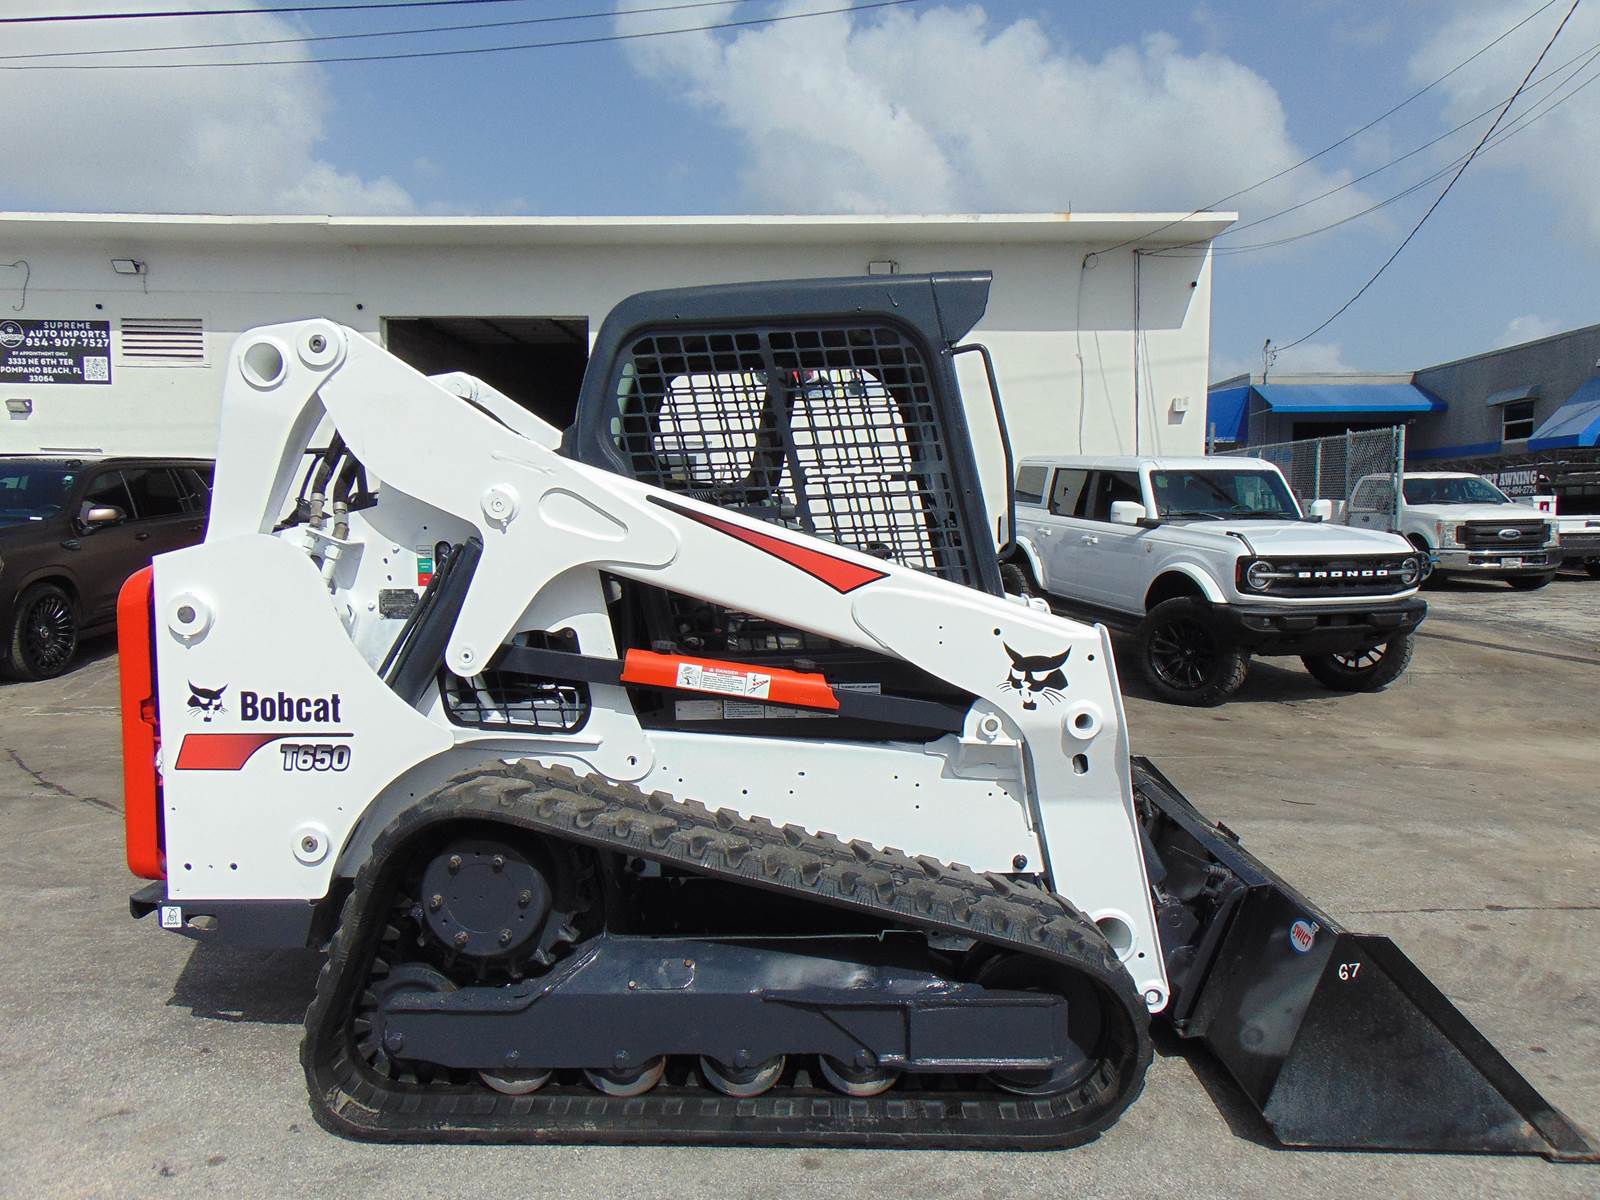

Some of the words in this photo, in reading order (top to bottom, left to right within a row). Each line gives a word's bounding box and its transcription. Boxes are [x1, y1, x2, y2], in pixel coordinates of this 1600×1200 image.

[28, 330, 58, 338] AUTO
[60, 330, 107, 338] IMPORTS
[25, 338, 110, 347] 954-907-7527
[8, 357, 27, 365] 3333
[59, 358, 74, 366] TER
[0, 366, 41, 374] POMPANO
[42, 367, 72, 375] BEACH,
[1499, 470, 1537, 486] AWNING
[1298, 569, 1388, 579] BRONCO
[240, 691, 341, 723] Bobcat
[280, 743, 351, 772] T650
[1338, 962, 1361, 981] 67
